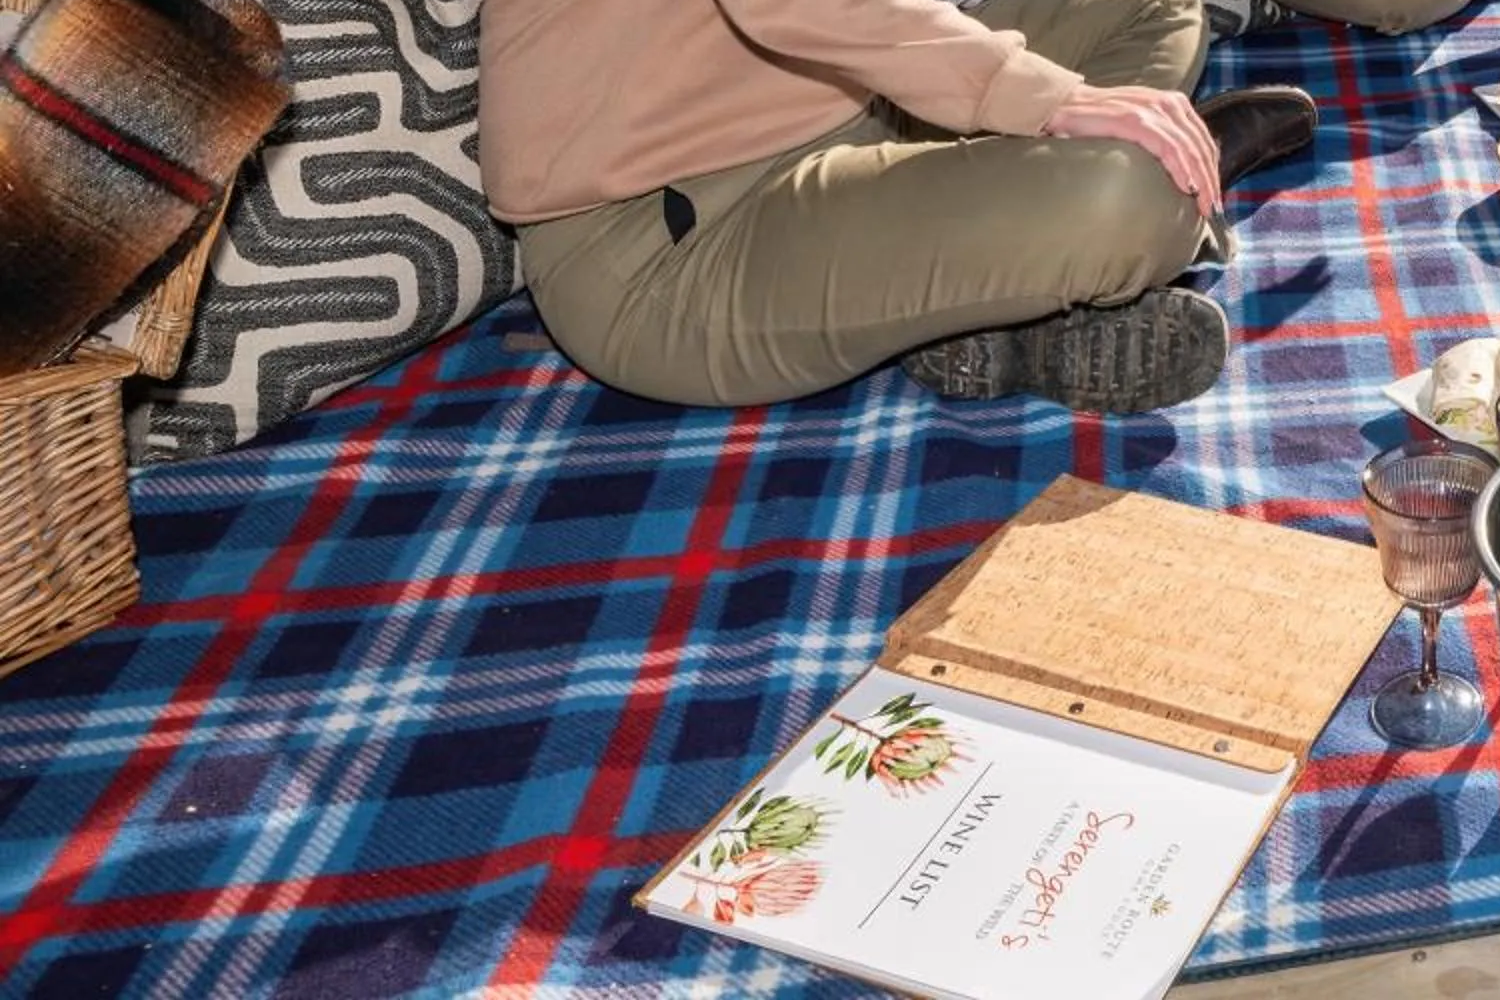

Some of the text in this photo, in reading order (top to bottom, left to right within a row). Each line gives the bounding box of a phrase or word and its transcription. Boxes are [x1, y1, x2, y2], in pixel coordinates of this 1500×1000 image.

[900, 795, 1002, 910] WINE LIST
[1001, 811, 1135, 950] Serengeti's
